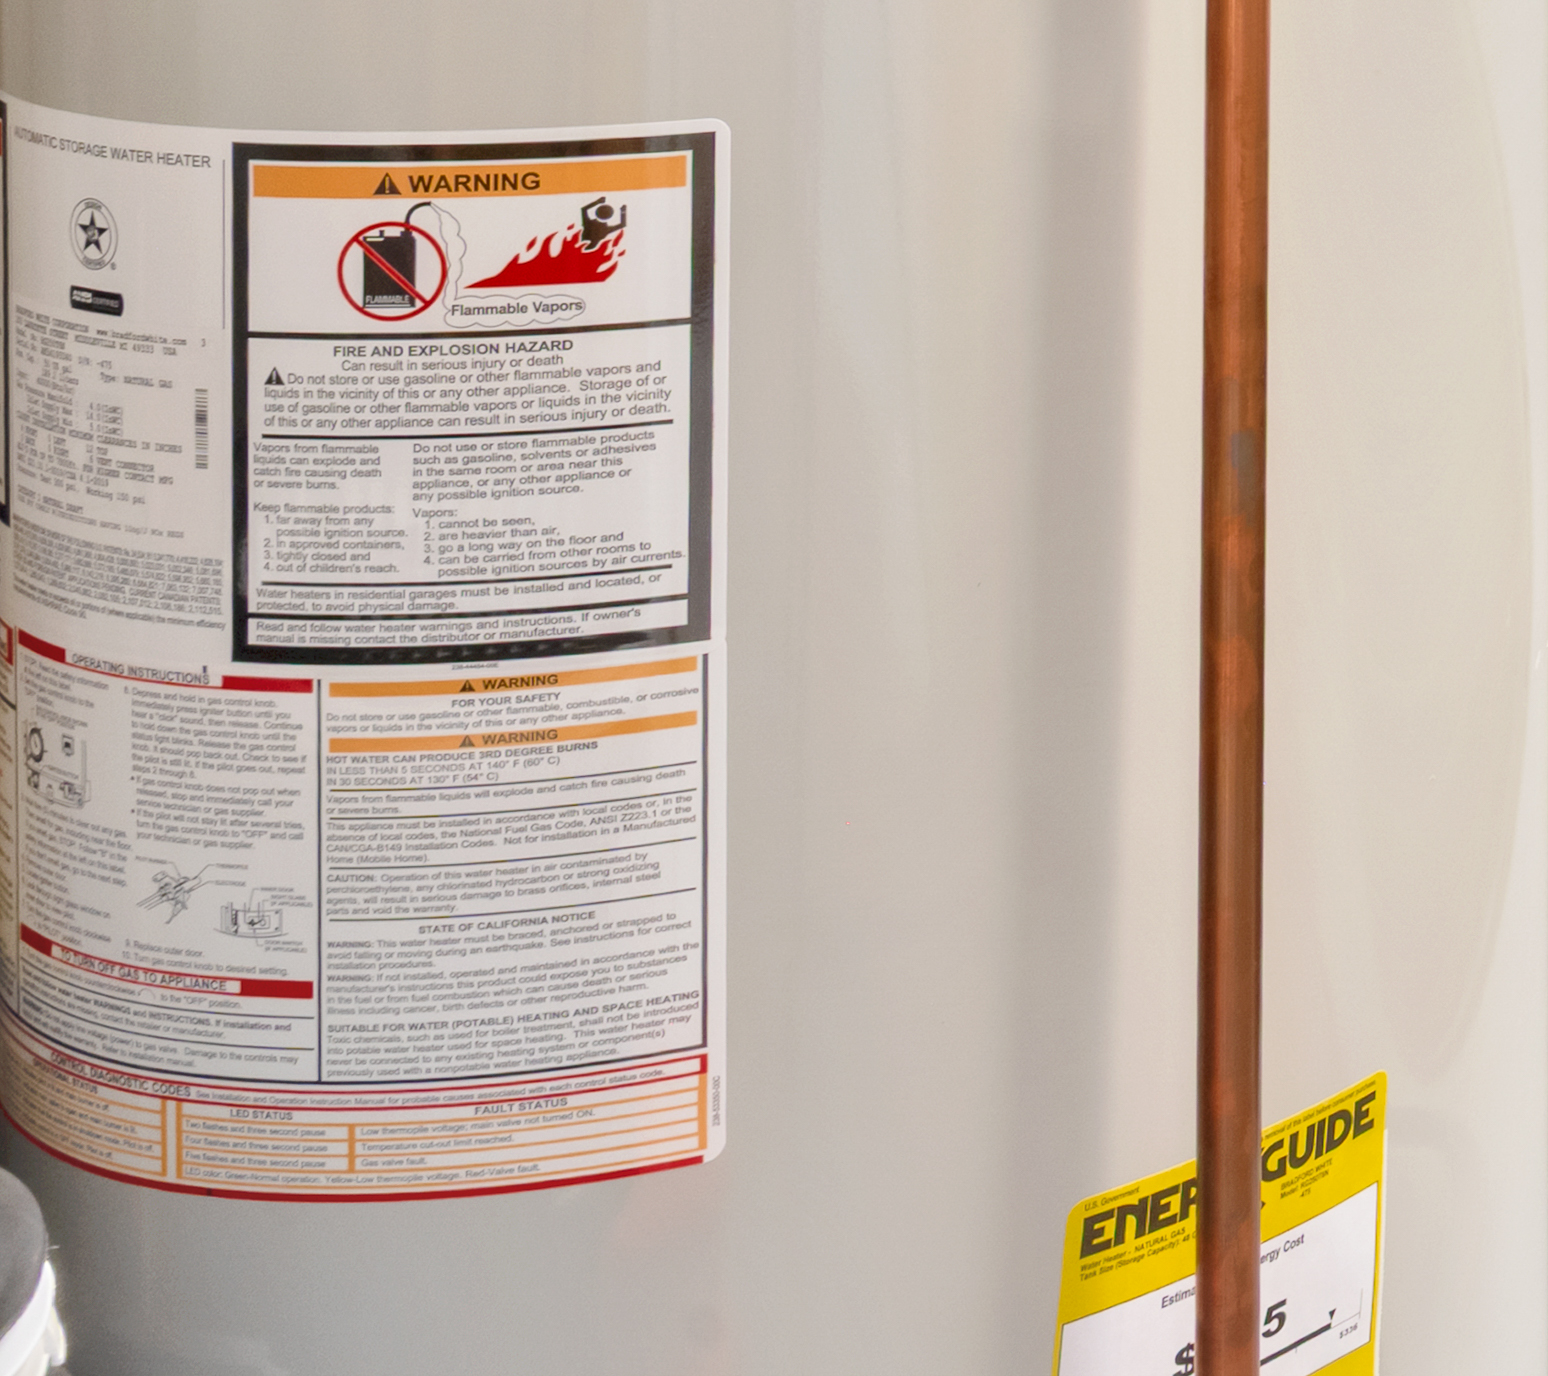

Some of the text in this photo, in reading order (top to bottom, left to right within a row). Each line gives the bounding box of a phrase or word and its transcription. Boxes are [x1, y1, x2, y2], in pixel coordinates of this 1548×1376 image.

[408, 172, 541, 193] WARNING
[451, 300, 583, 316] Flammable Vapors
[333, 340, 574, 357] FIRE AND EXPLOSION HAZARD
[341, 355, 564, 372] Can result in serious injury or death
[482, 674, 559, 690] WARNING
[482, 729, 558, 745] WARNING
[1283, 1234, 1305, 1252] Cost
